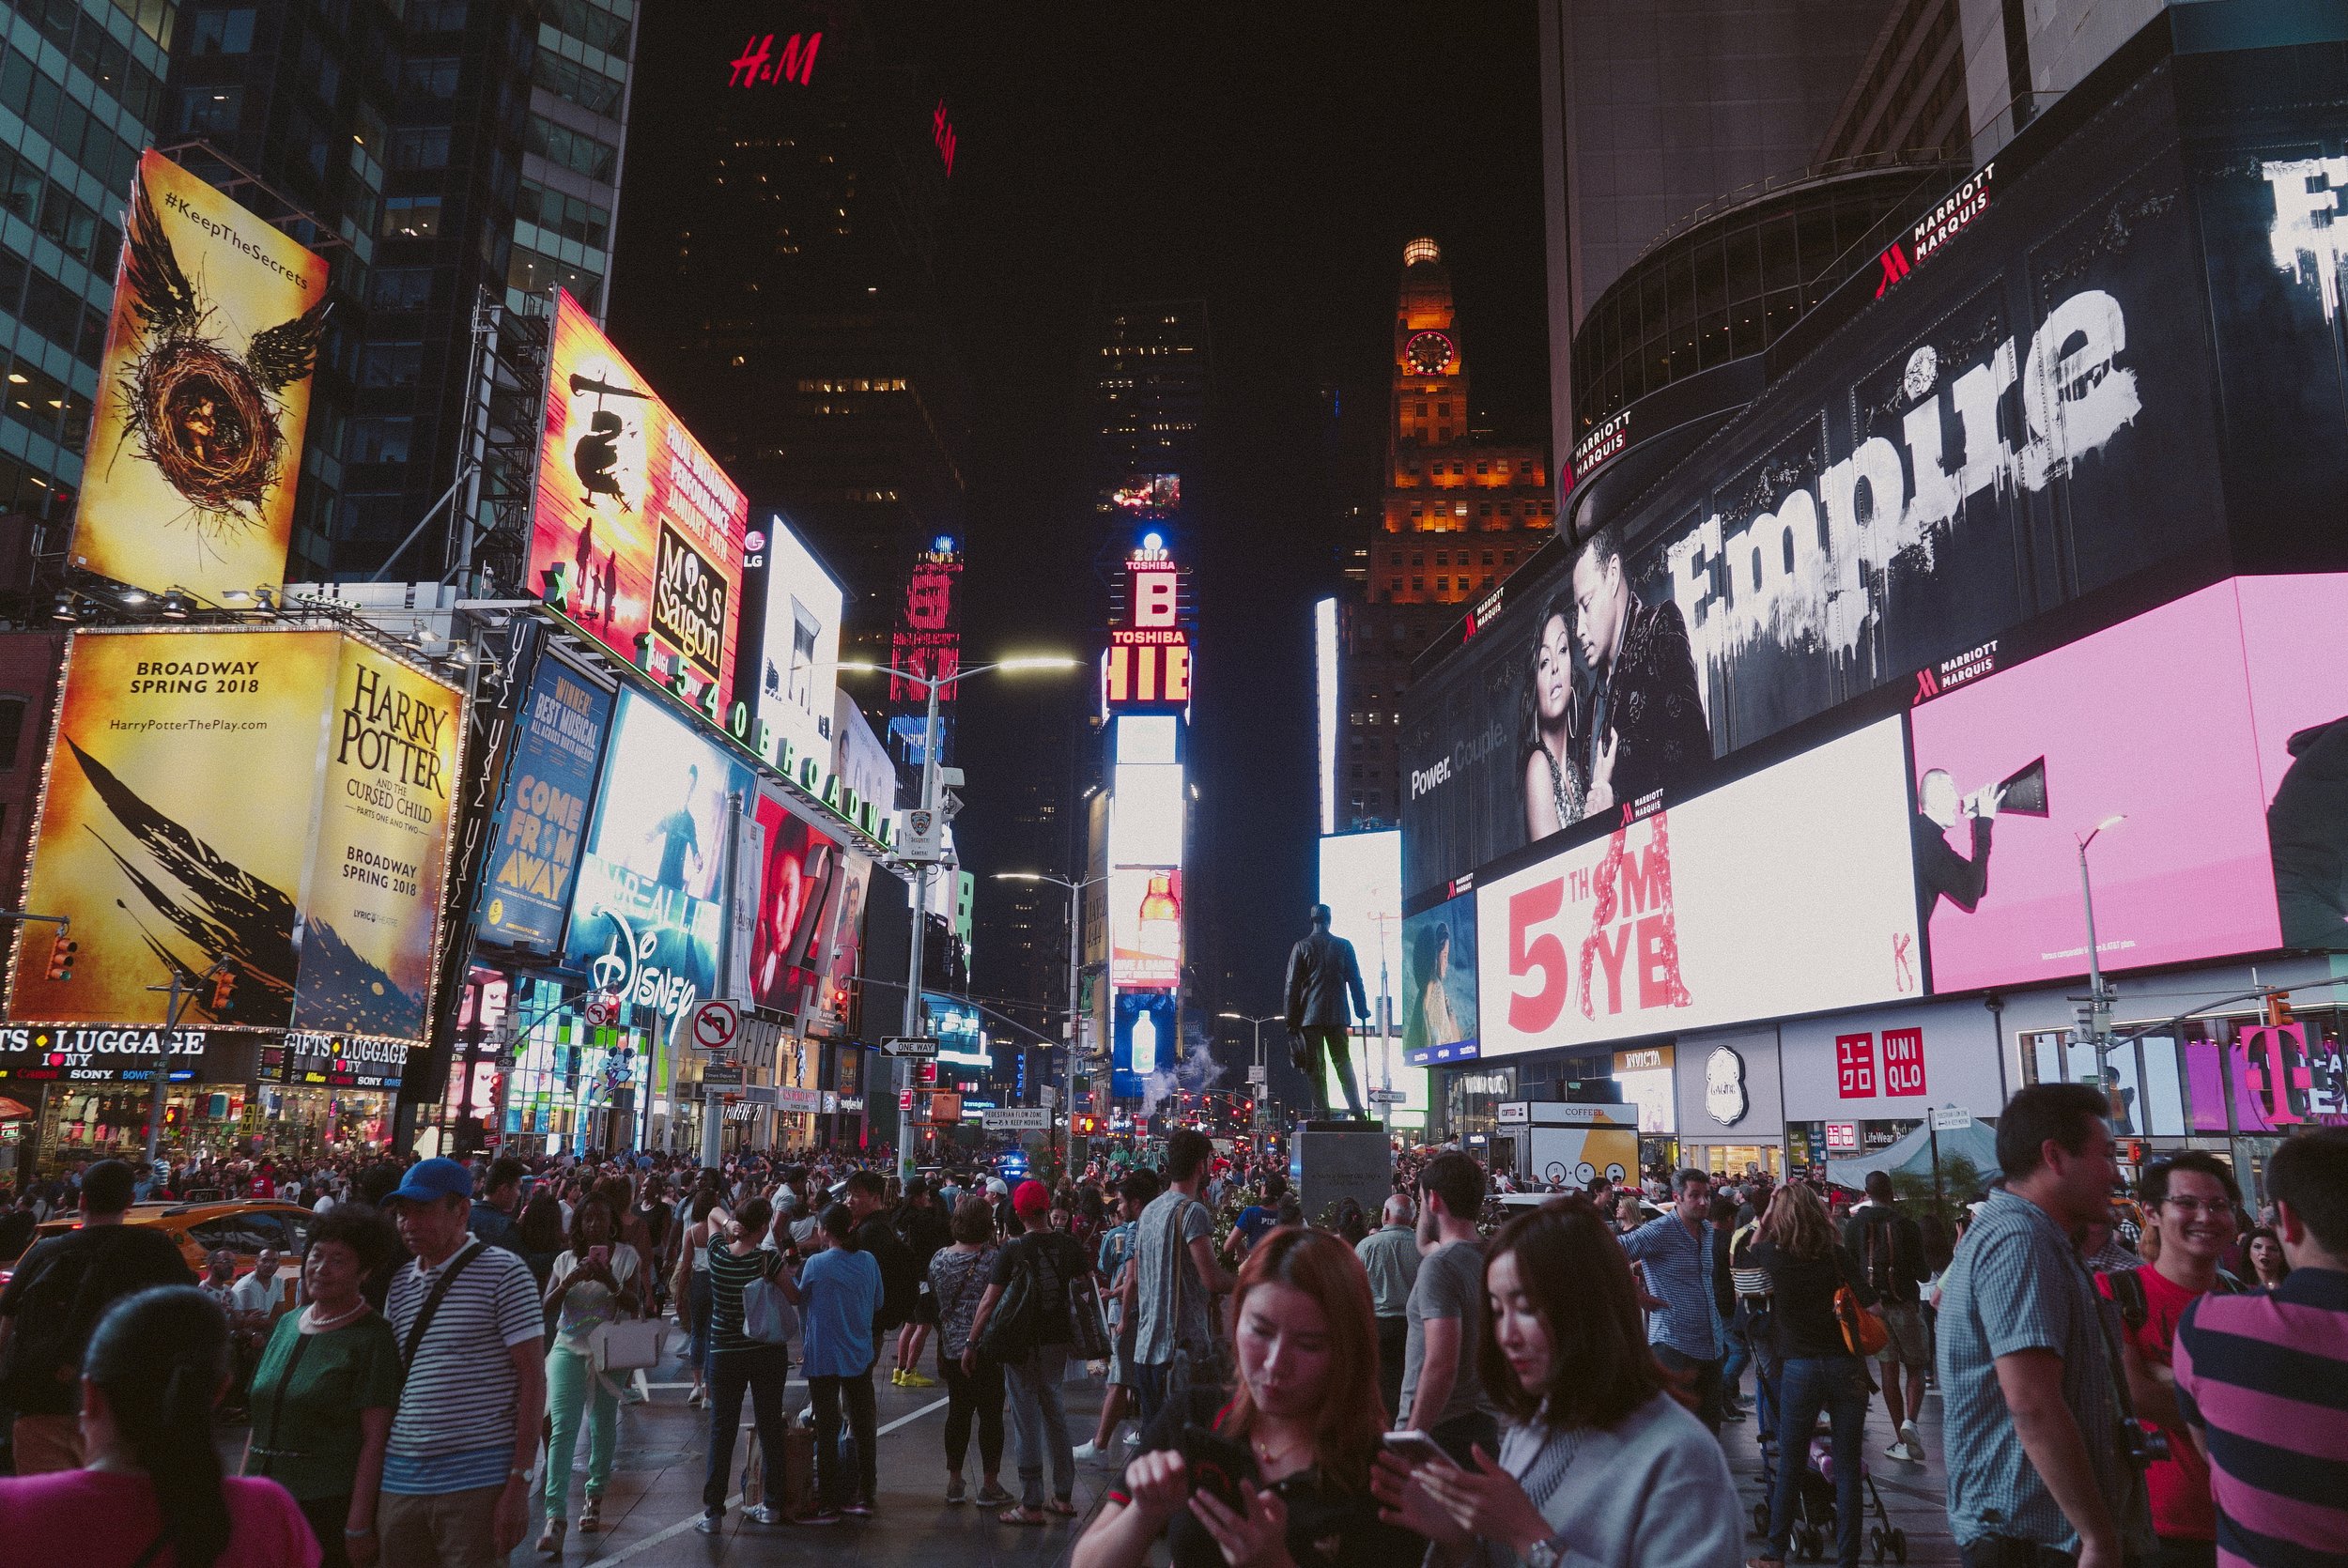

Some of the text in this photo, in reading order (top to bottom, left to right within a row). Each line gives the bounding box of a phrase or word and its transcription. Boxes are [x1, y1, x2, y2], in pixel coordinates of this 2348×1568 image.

[729, 32, 823, 88] H&M
[1915, 162, 1994, 240] MARRIOTT
[1917, 192, 1986, 260] MARQUIS
[164, 191, 308, 290] #KeepTheSecrets
[1576, 411, 1630, 461] MARRIOTT
[667, 423, 737, 515] FINAL BROADWAY
[1576, 434, 1623, 479] MARQUIS
[1667, 289, 2142, 671] Empire
[671, 455, 730, 536] PERFORMANCE
[668, 484, 727, 562] JANUARY 14TH
[744, 556, 763, 567] LG
[1126, 561, 1175, 570] TOSHIBA
[1134, 549, 1167, 561] 2017
[301, 592, 356, 608] LAMAR
[1476, 587, 1504, 616] MARRIOTT
[657, 576, 718, 668] Saigon
[1477, 602, 1501, 628] MARQUIS
[1113, 631, 1184, 644] TOSHIBA
[136, 661, 259, 675] BROADWAY
[1940, 640, 1998, 673] MARRIOTT
[131, 680, 259, 693] SPRING 2018
[1942, 659, 1993, 687] MARQUIS
[351, 663, 448, 751] HARRY
[556, 676, 592, 718] WINNER!
[110, 719, 268, 732] HarryPotterThePlay.com
[531, 719, 541, 735] ALL
[534, 692, 597, 751] BEST MUSICAL
[337, 708, 445, 799] POTTER
[378, 777, 407, 796] AND THE
[758, 718, 892, 846] BROADWA
[1412, 756, 1451, 800] Power.
[347, 778, 432, 824] CURSED CHILD
[517, 775, 584, 833] COME
[1634, 788, 1663, 808] MARRIOTT
[1635, 800, 1661, 818] MARQUIS
[357, 806, 418, 834] PARTS ONE AND TWO
[348, 846, 417, 878] BROADWAY
[496, 848, 569, 901] AWAY
[343, 864, 416, 896] SPRING 2018
[354, 909, 371, 920] LYRIC
[42, 1053, 92, 1067] I NY
[341, 1038, 409, 1065] LUGGAGE
[898, 1043, 934, 1052] ONE WAY
[1625, 1050, 1661, 1068] INVICTA
[1886, 1037, 1916, 1061] UNI
[70, 1069, 114, 1079] SONY
[305, 1072, 326, 1083] Nikon
[358, 1076, 382, 1086] SONY
[384, 1078, 402, 1087] BOWER
[332, 1059, 362, 1073] I NY
[1889, 1064, 1922, 1092] QLO
[241, 1105, 254, 1131] ATM
[255, 1106, 264, 1132] ATM
[725, 1102, 754, 1120] FOREVE
[1863, 1131, 1894, 1144] LifeWear
